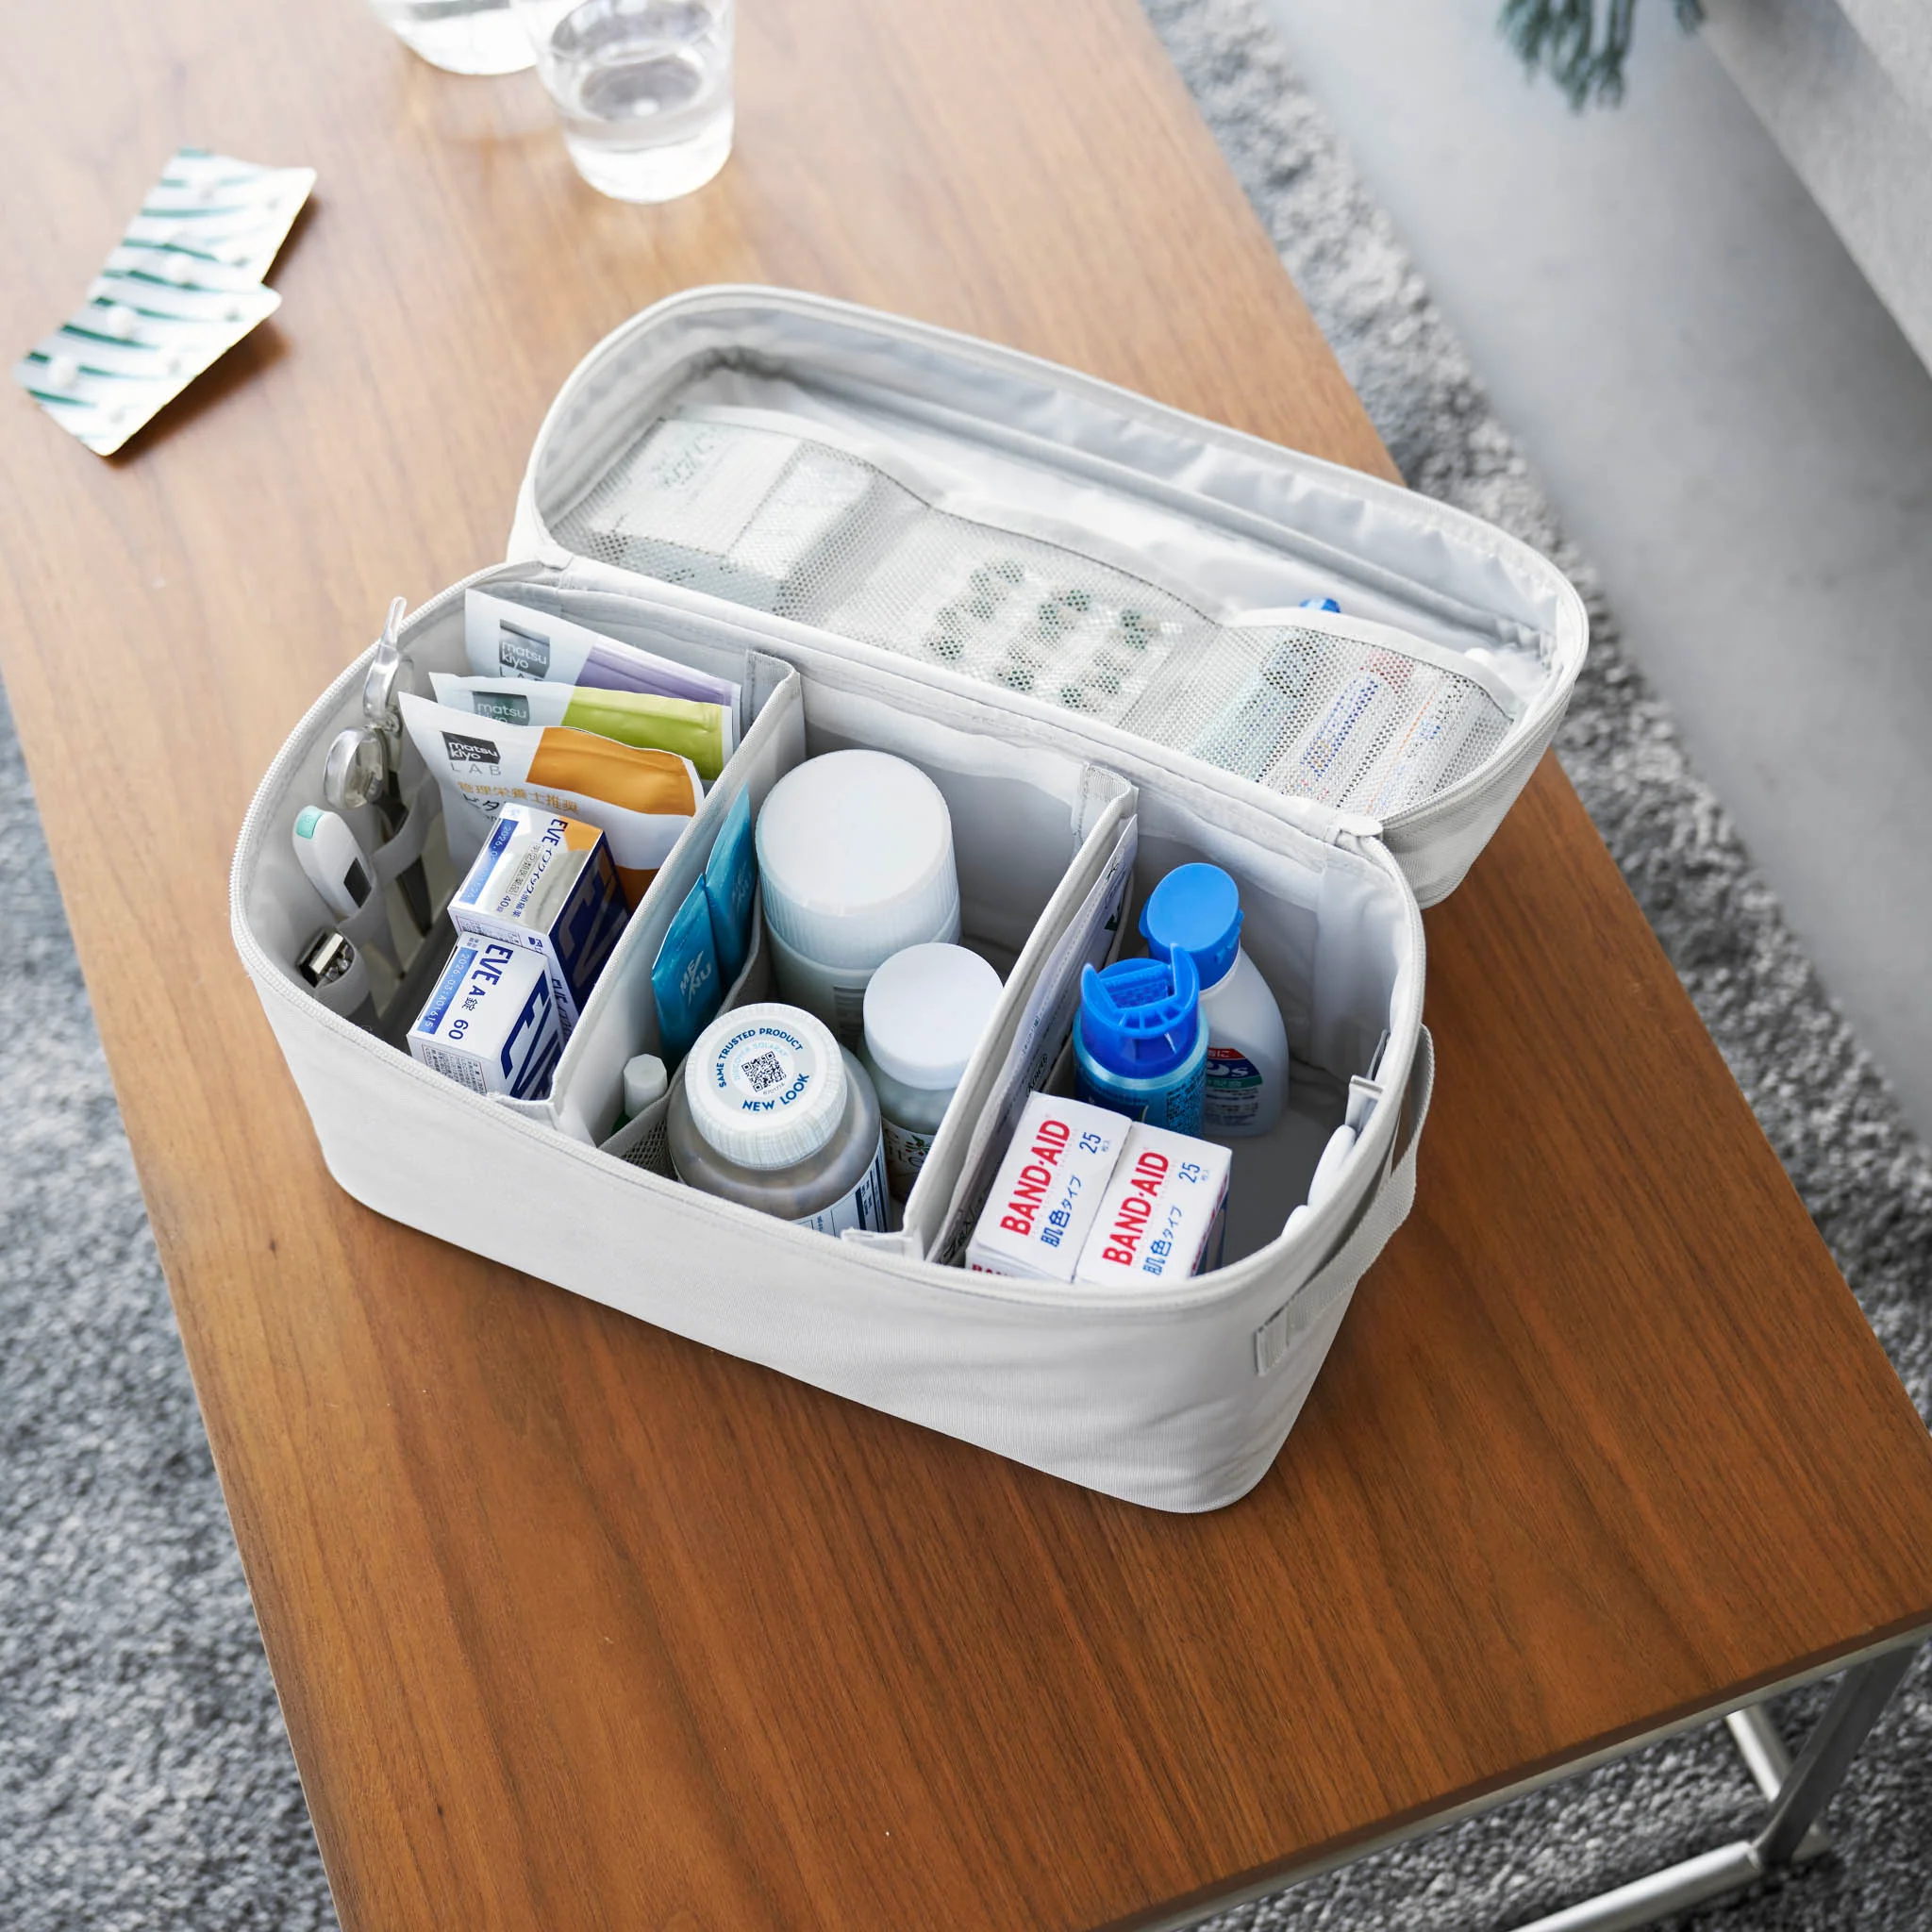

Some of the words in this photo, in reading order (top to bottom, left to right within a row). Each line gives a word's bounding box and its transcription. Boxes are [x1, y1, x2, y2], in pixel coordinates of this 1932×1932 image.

[502, 641, 547, 664] matsu
[502, 648, 528, 669] kiyo
[477, 703, 527, 718] matsu
[448, 741, 497, 758] matsu
[450, 749, 481, 761] kiyo
[541, 818, 569, 846] EVE
[472, 943, 514, 986] EVE
[448, 1019, 470, 1041] 60
[758, 1027, 804, 1052] PRODUCT
[718, 1029, 756, 1059] TRUSTED
[716, 1062, 727, 1089] SAME
[741, 1099, 775, 1112] NEW
[779, 1073, 810, 1106] LOOK
[1078, 1131, 1102, 1155] 25
[1178, 1161, 1201, 1184] 25
[1041, 1174, 1082, 1248] 肌色タイプ
[1142, 1204, 1183, 1276] 肌色タイプ
